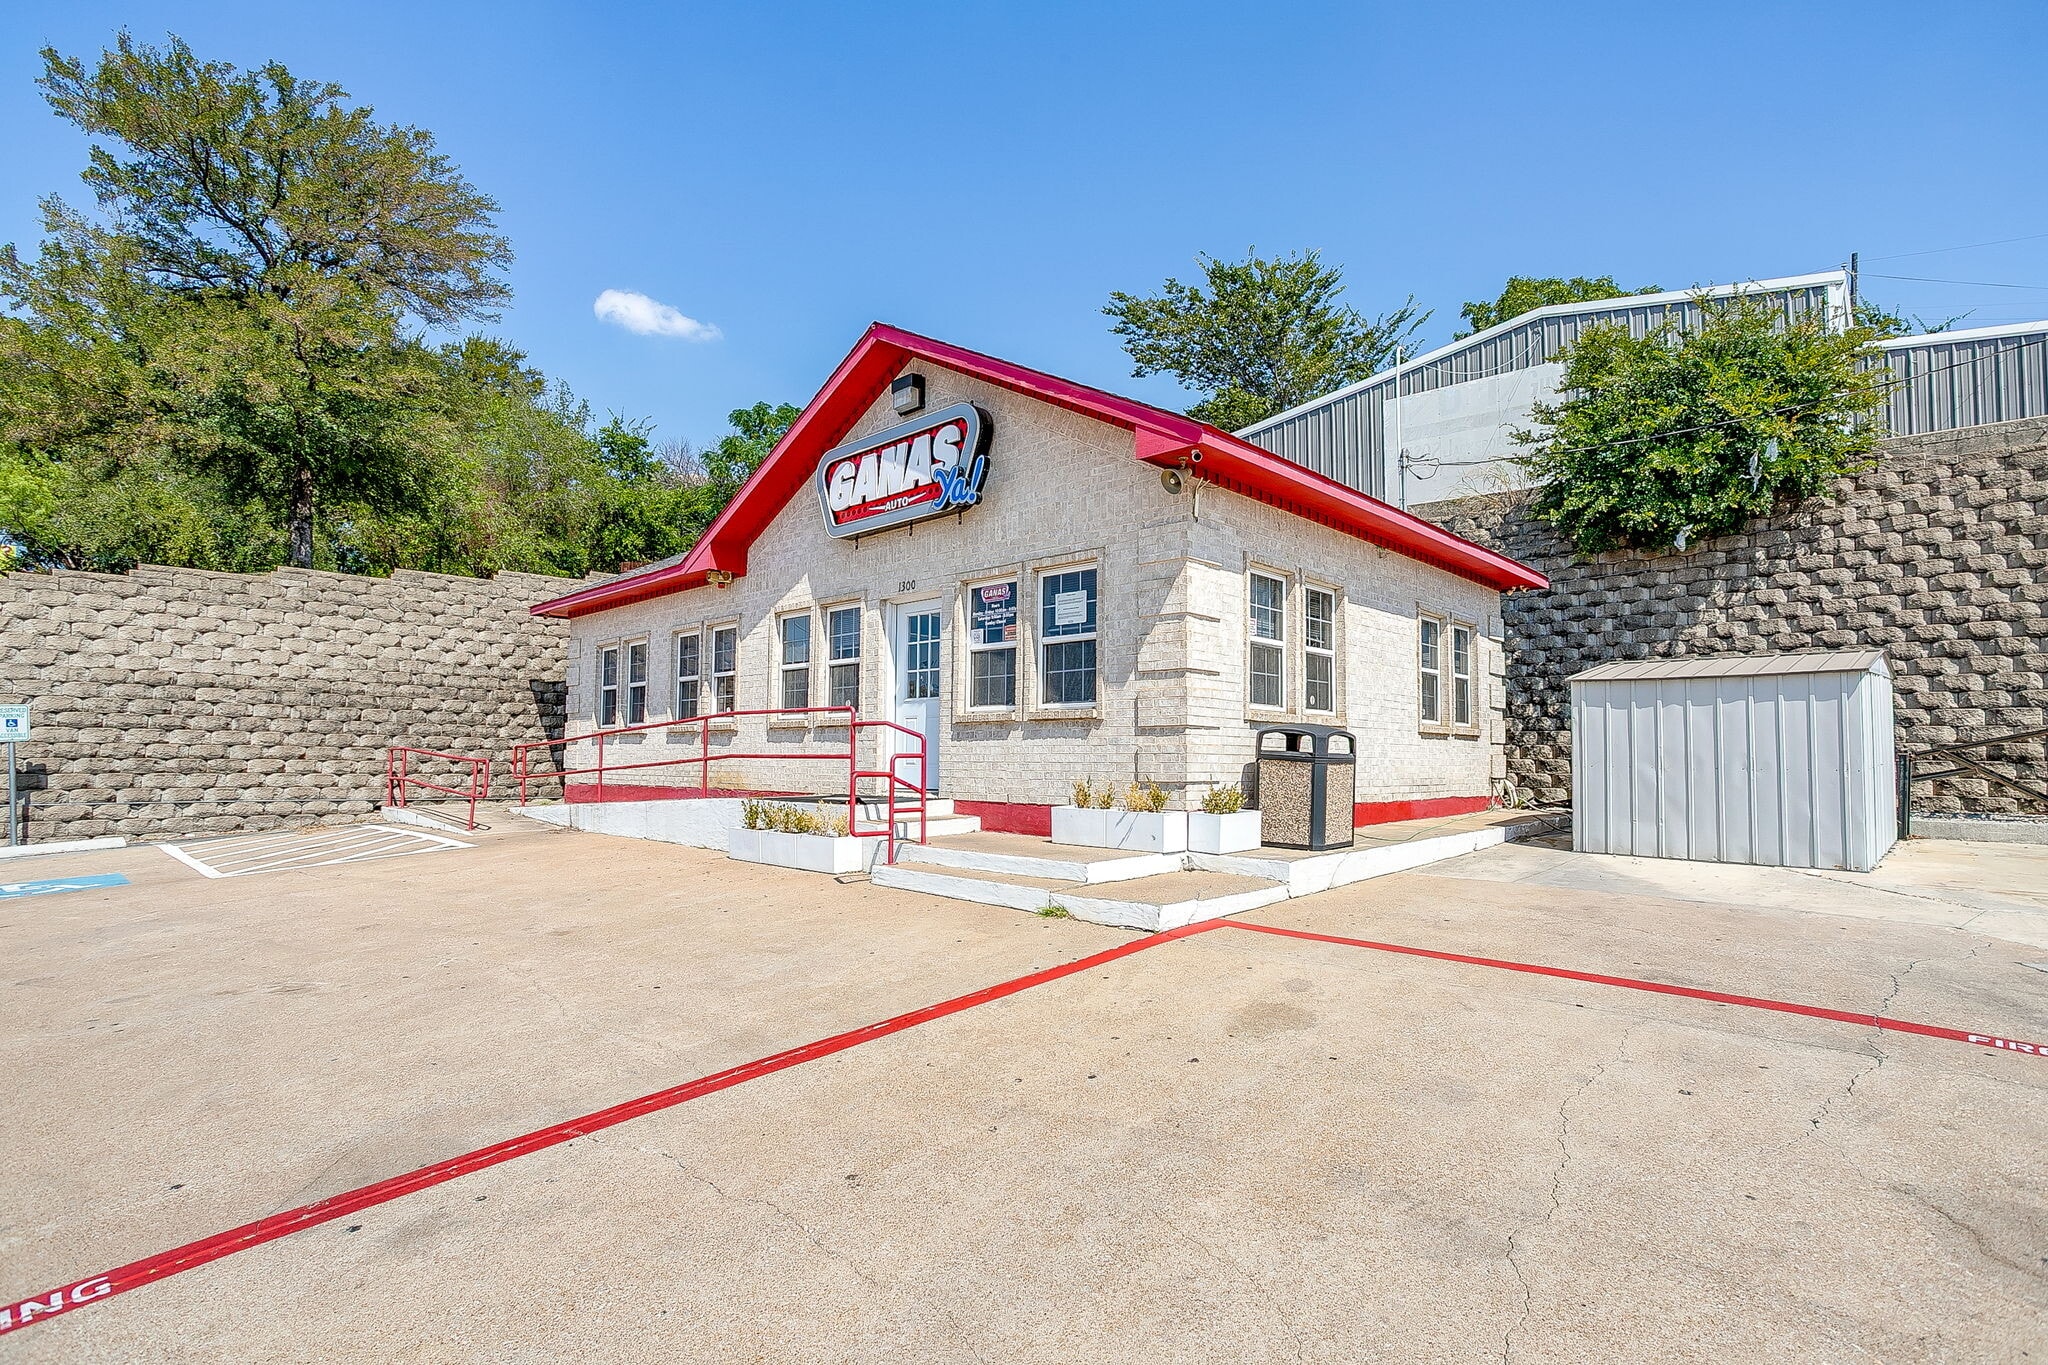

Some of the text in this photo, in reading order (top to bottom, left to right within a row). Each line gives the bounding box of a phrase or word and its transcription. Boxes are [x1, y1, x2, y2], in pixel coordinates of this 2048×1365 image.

[829, 424, 961, 511] GANAS
[932, 454, 985, 511] Ya!
[884, 496, 910, 511] AUTO
[898, 580, 916, 592] 1300
[984, 588, 1006, 598] GANAS
